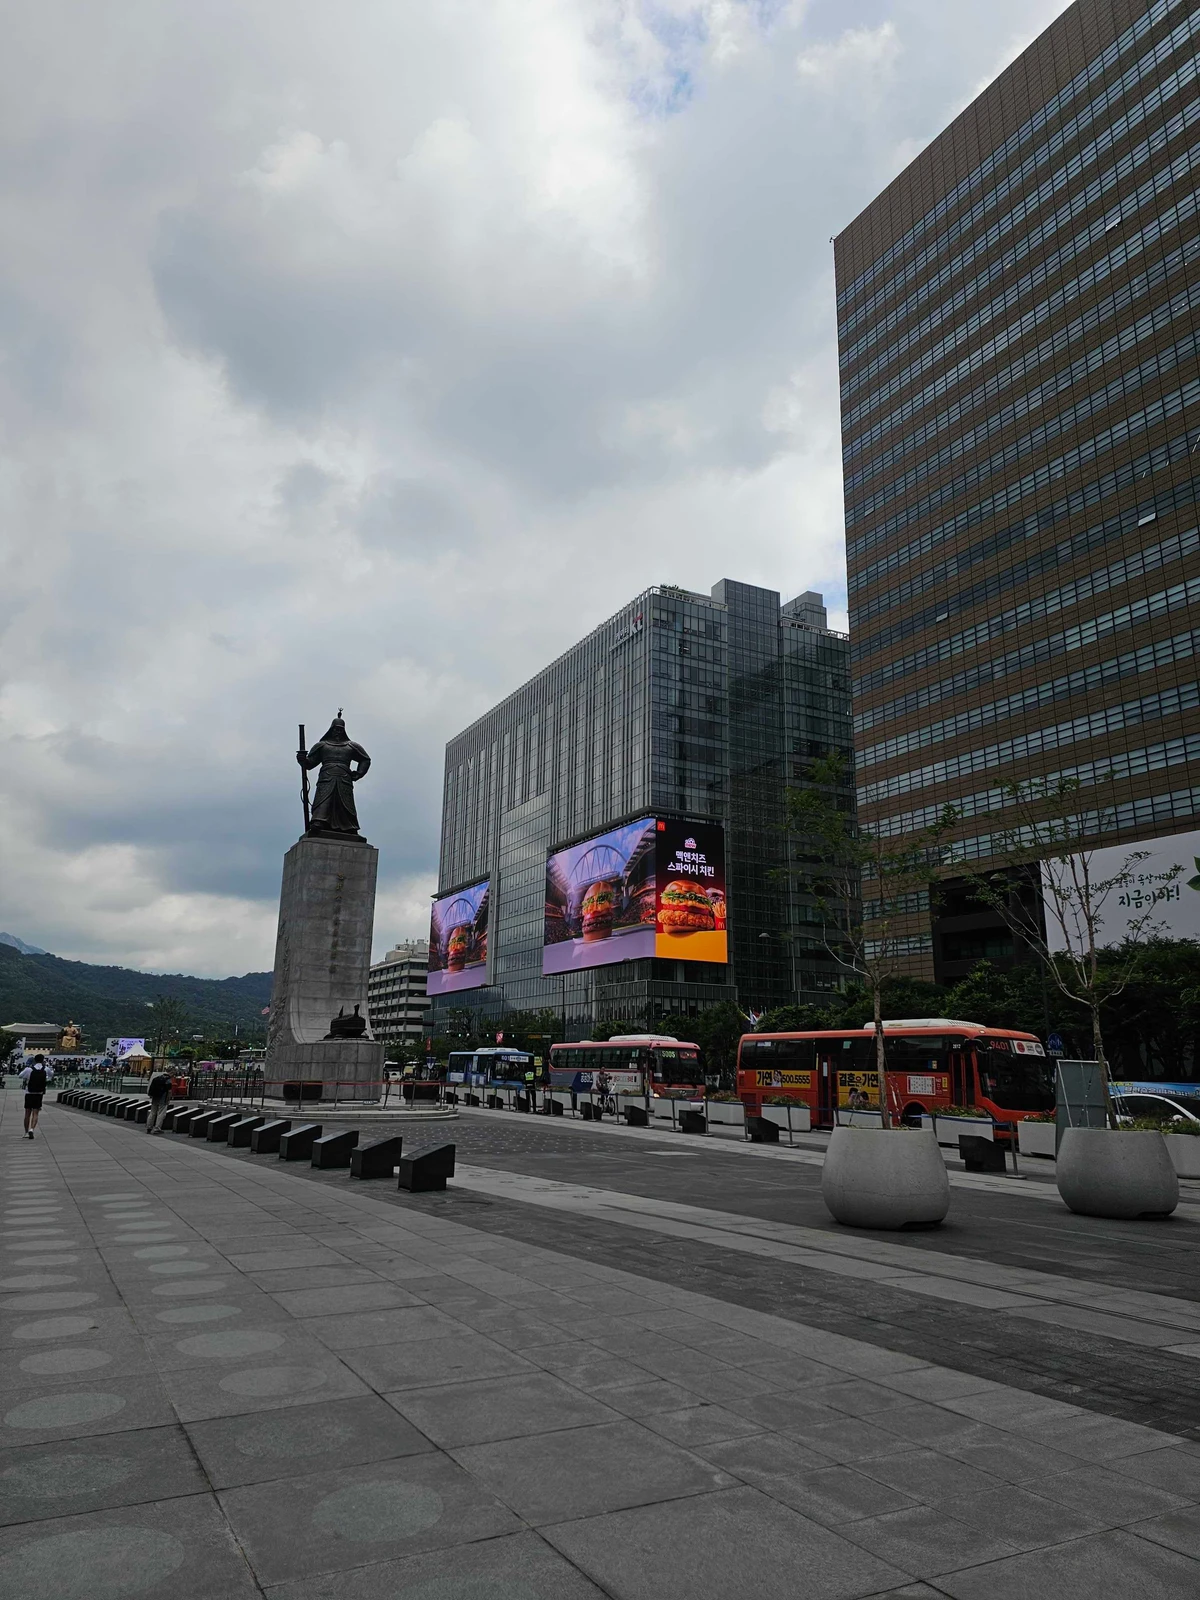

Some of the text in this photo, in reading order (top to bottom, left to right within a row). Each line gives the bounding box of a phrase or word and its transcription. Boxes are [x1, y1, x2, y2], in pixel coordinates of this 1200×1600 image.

[676, 850, 706, 864] 맥앤치즈
[667, 861, 714, 877] 스파이시 치킨
[1118, 884, 1180, 909] 지금이야!
[990, 1040, 1009, 1050] 9401
[757, 1071, 772, 1086] 가연
